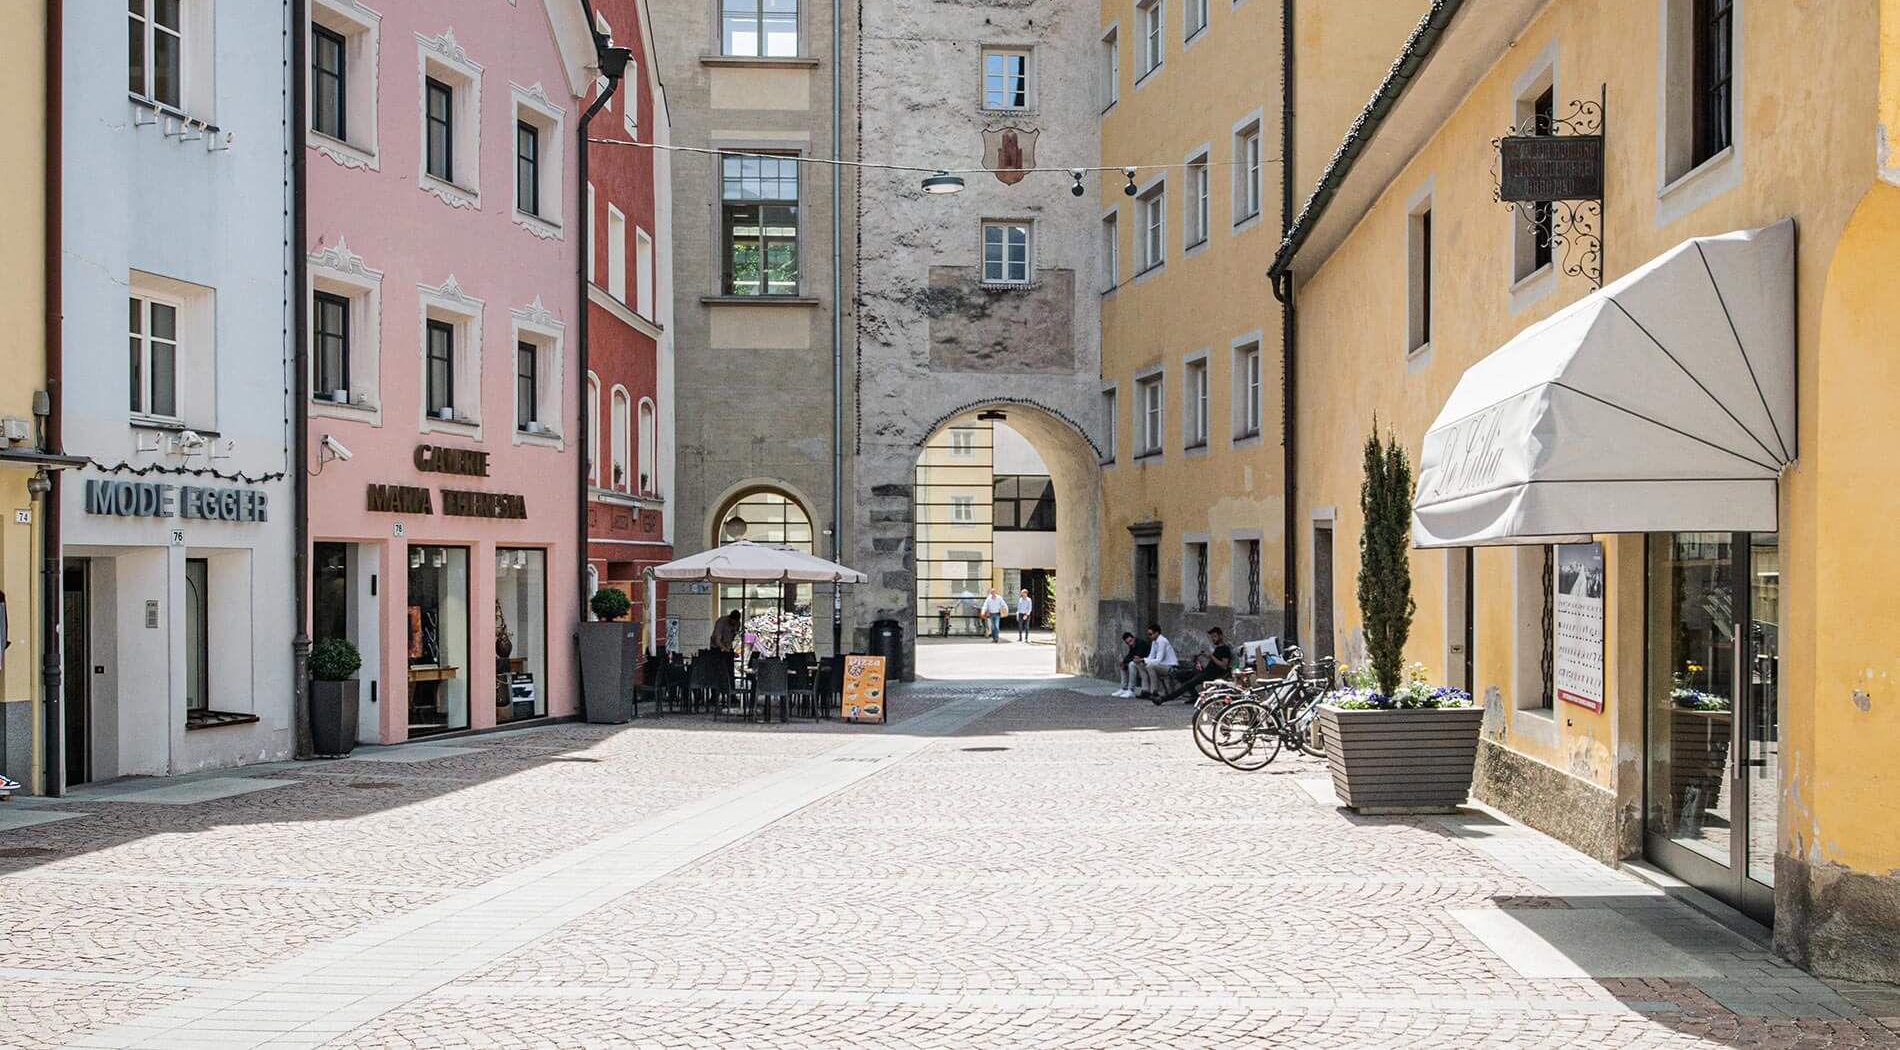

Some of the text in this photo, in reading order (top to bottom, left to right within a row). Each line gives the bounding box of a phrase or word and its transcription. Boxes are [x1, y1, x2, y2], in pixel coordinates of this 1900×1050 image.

[86, 479, 269, 522] MODE EGGER
[366, 483, 434, 515] MARIA
[19, 512, 28, 522] 74
[173, 531, 183, 542] 76
